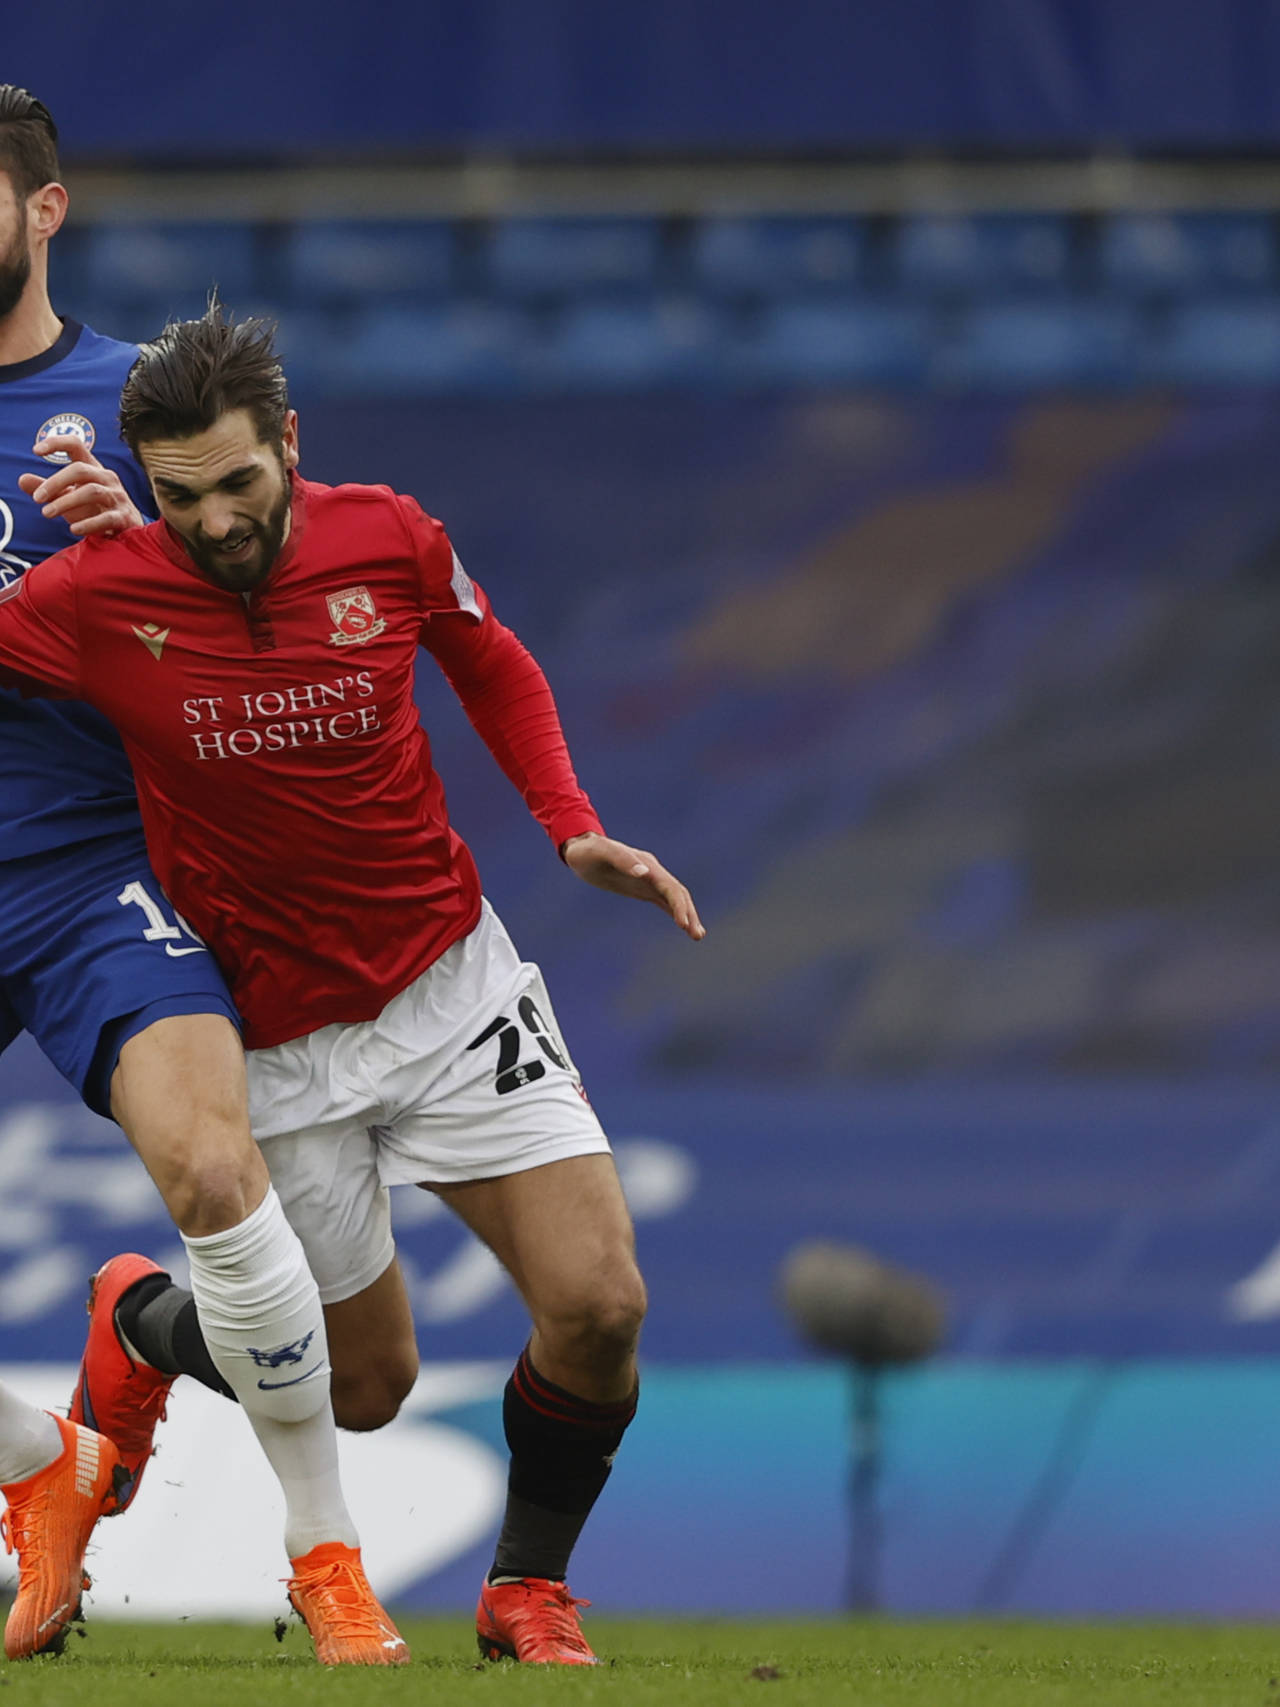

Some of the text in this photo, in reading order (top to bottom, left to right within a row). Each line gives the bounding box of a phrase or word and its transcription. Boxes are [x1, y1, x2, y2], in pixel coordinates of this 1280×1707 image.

[182, 670, 375, 725] ST JOHN'S
[190, 704, 382, 760] HOSPICE
